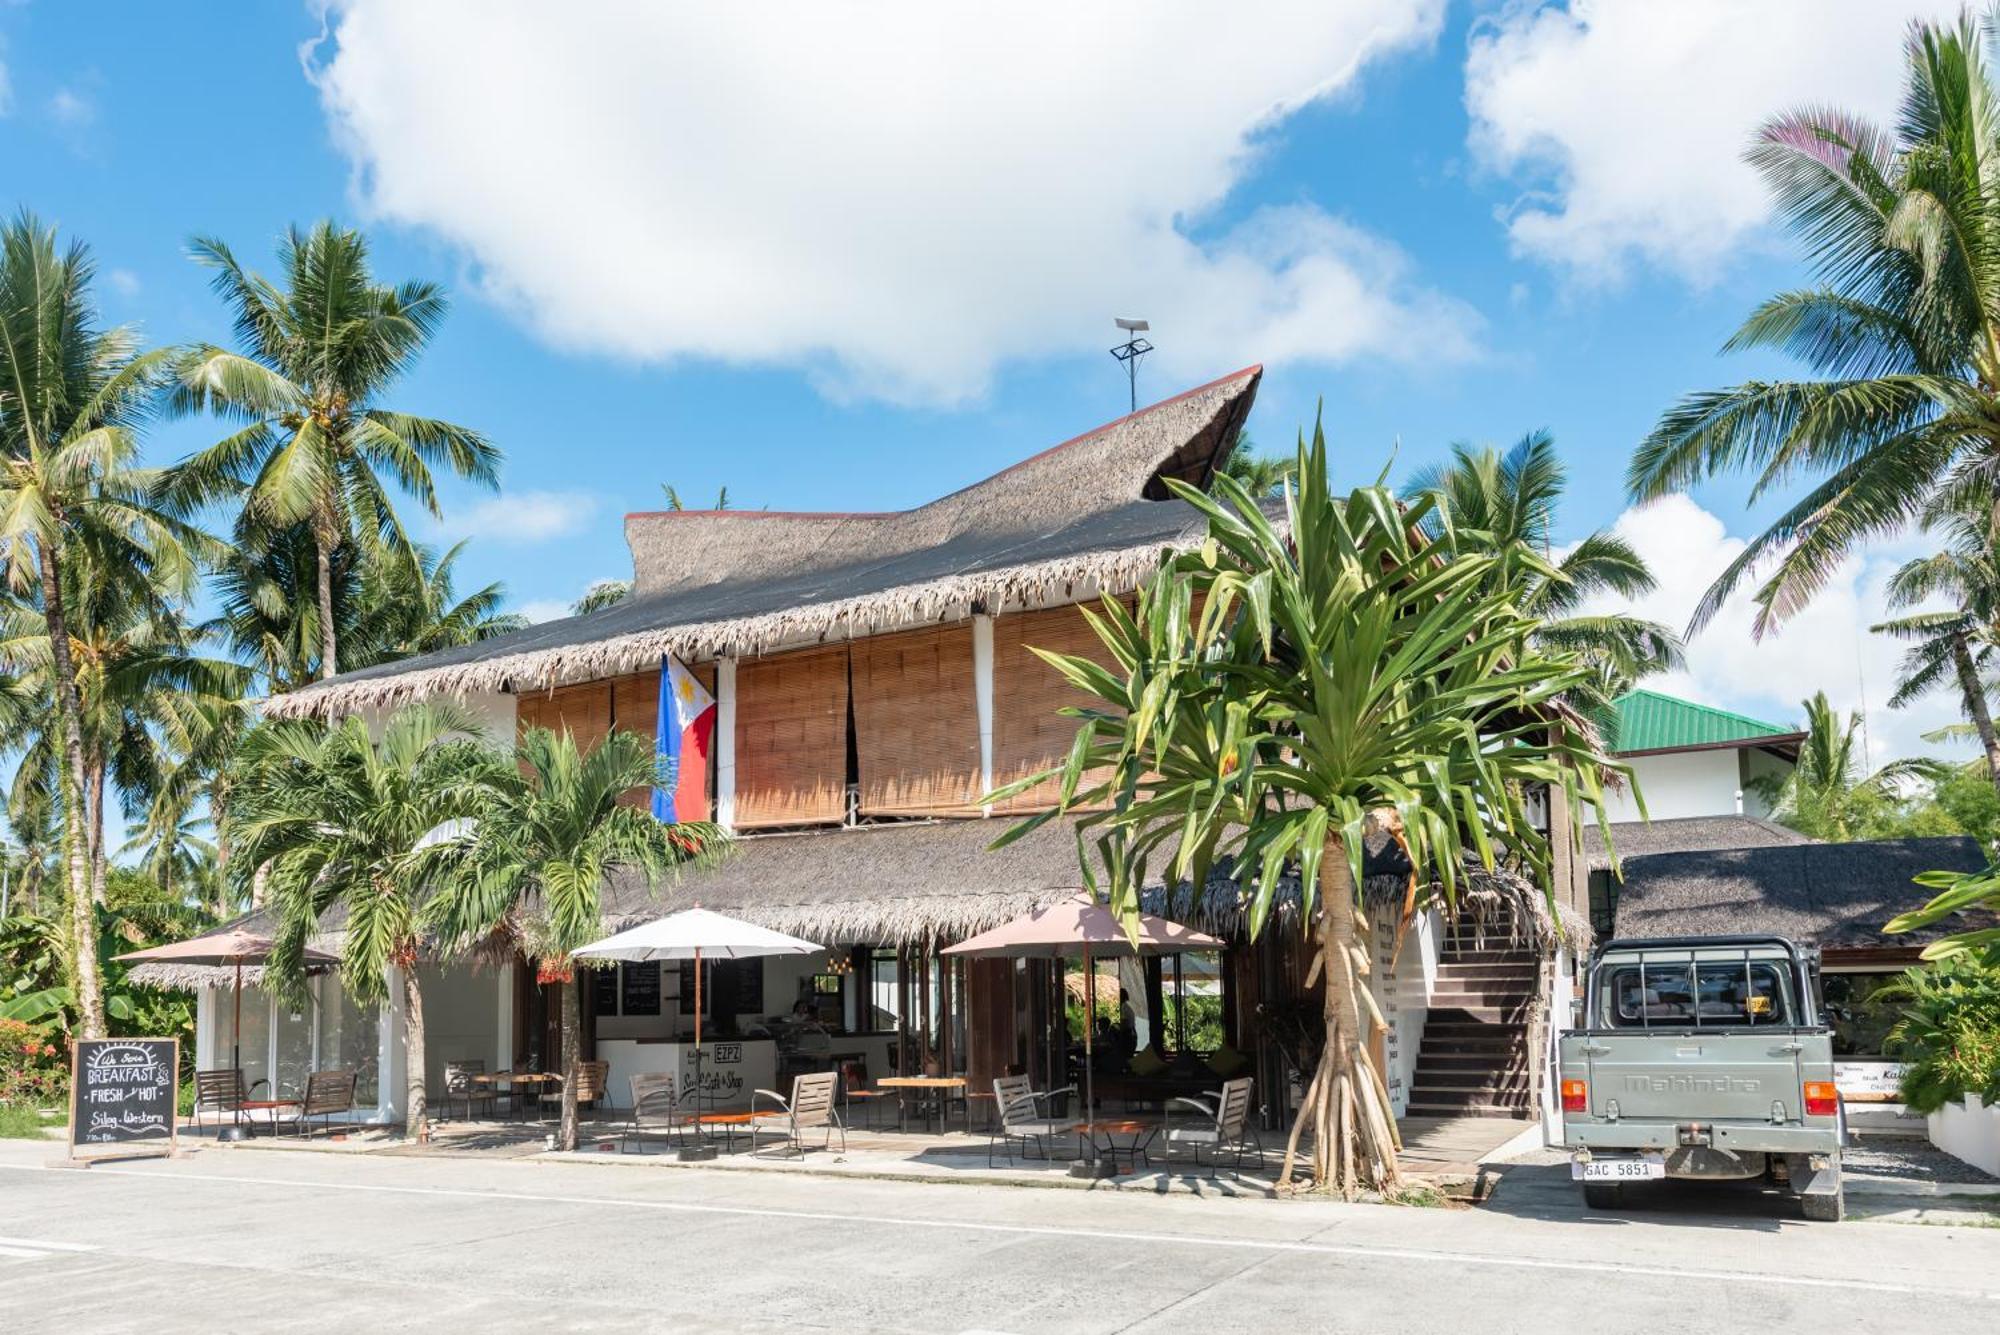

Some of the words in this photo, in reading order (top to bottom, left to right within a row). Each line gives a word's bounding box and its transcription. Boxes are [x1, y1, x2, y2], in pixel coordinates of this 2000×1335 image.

[717, 1046, 740, 1060] EZPZ
[87, 1066, 157, 1085] BREAKFAST
[1624, 1075, 1761, 1095] Mahindra
[90, 1088, 123, 1103] FRESH
[139, 1086, 158, 1101] HOT
[123, 1109, 164, 1124] Western
[1586, 1164, 1609, 1176] GAC
[1617, 1163, 1649, 1176] 5851
